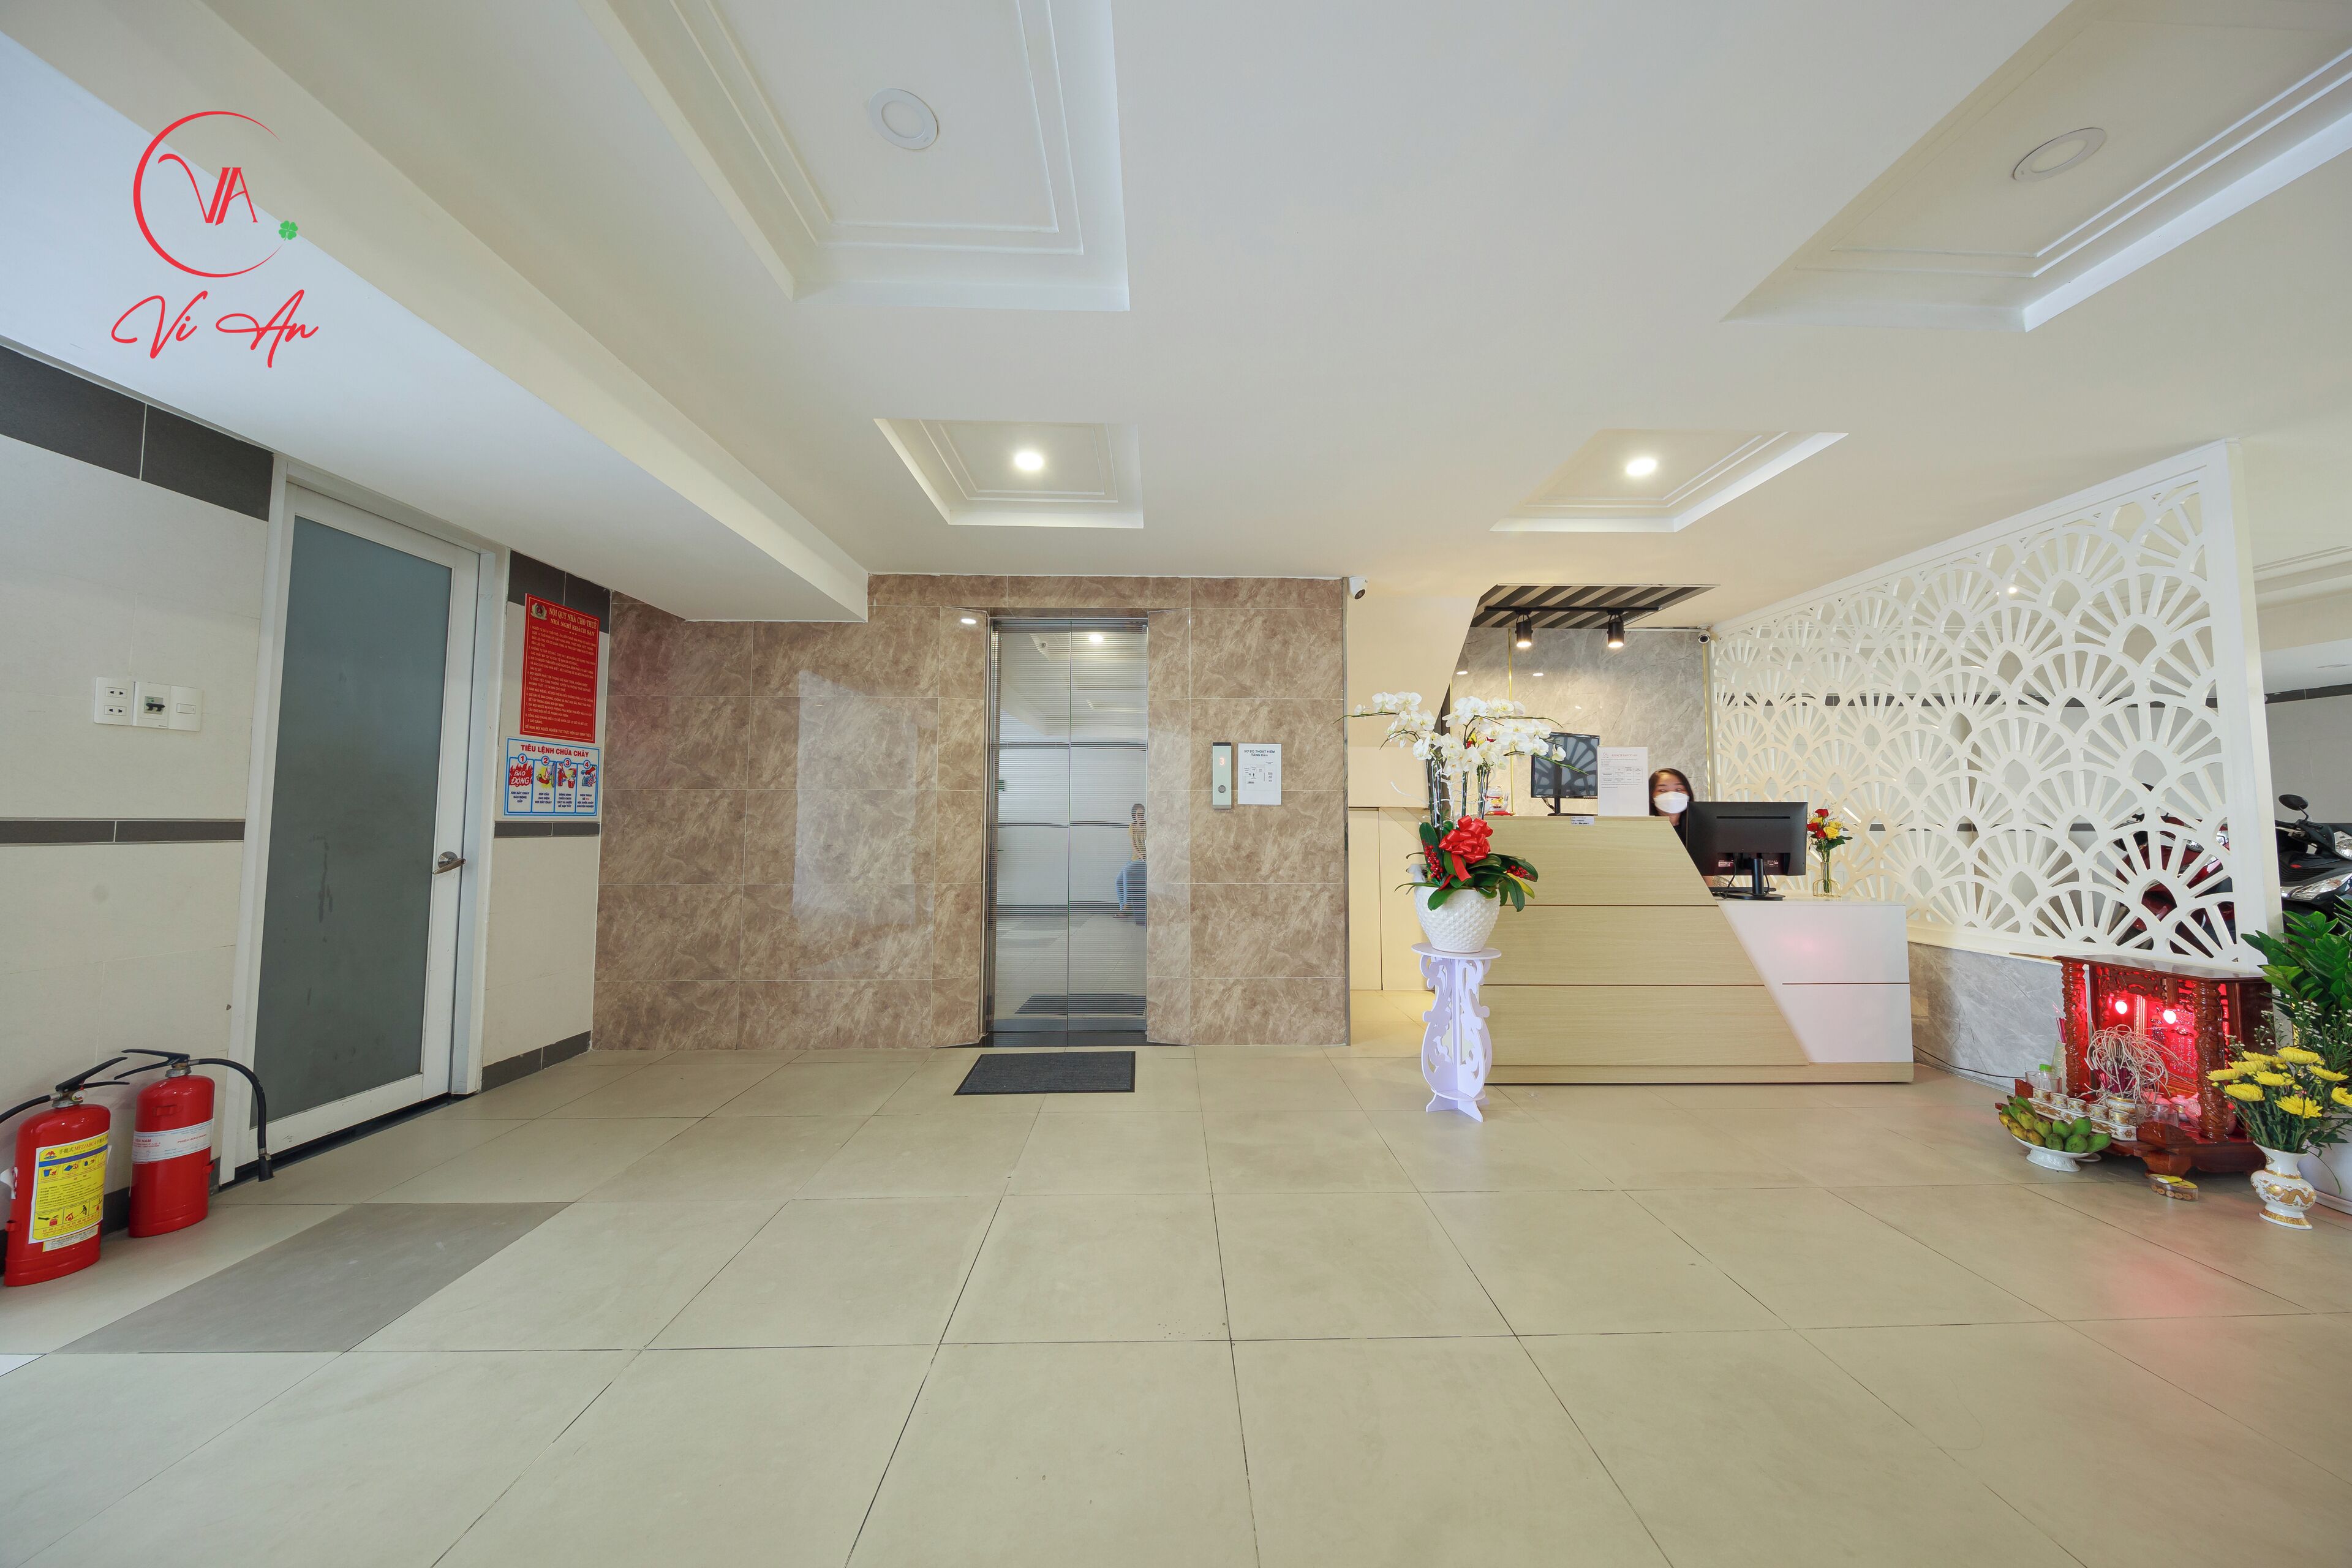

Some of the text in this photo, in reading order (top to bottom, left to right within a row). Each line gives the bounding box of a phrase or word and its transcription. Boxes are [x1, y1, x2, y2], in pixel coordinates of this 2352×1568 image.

[558, 611, 567, 619] QUY
[577, 617, 586, 625] CHO
[538, 745, 554, 755] LỆNH
[1219, 757, 1225, 766] 3
